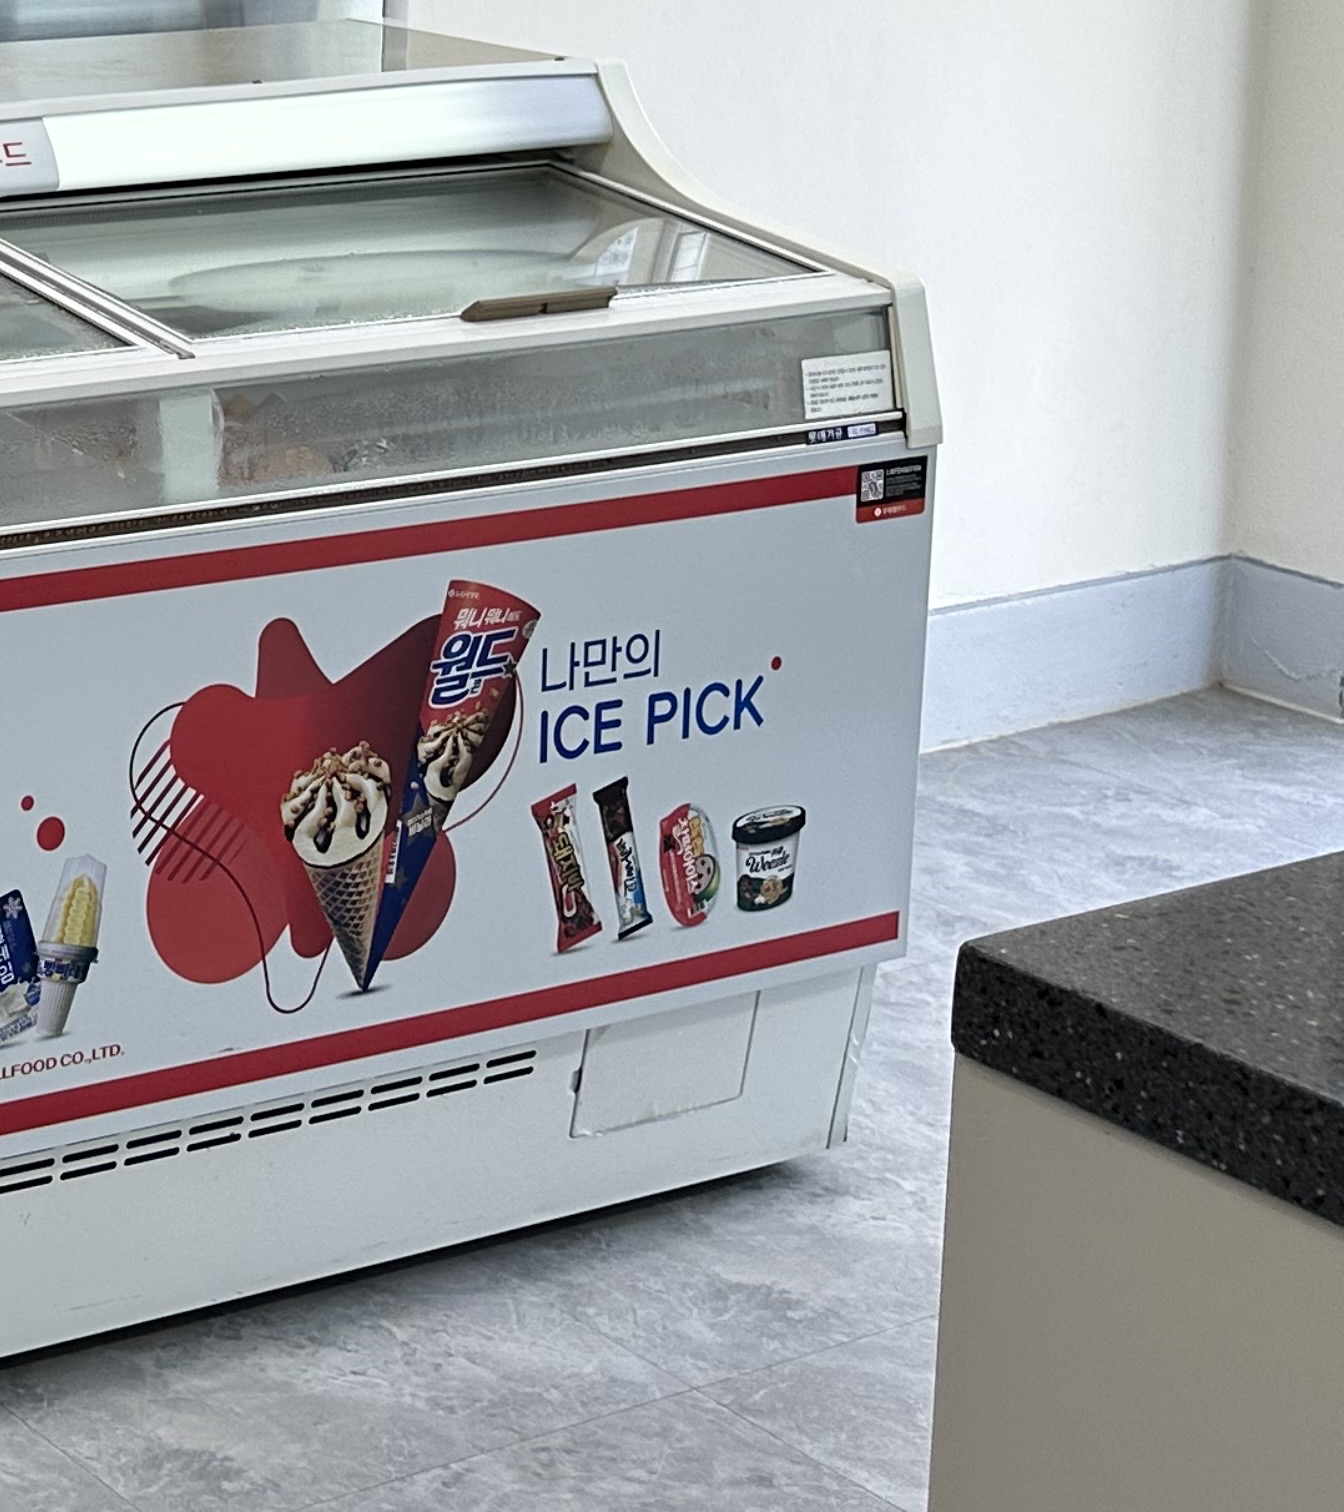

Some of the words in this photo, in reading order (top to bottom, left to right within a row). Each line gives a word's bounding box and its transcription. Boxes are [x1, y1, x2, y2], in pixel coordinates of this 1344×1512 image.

[541, 629, 661, 692] 나만의
[539, 698, 623, 764] ICE
[646, 675, 764, 745] PICK
